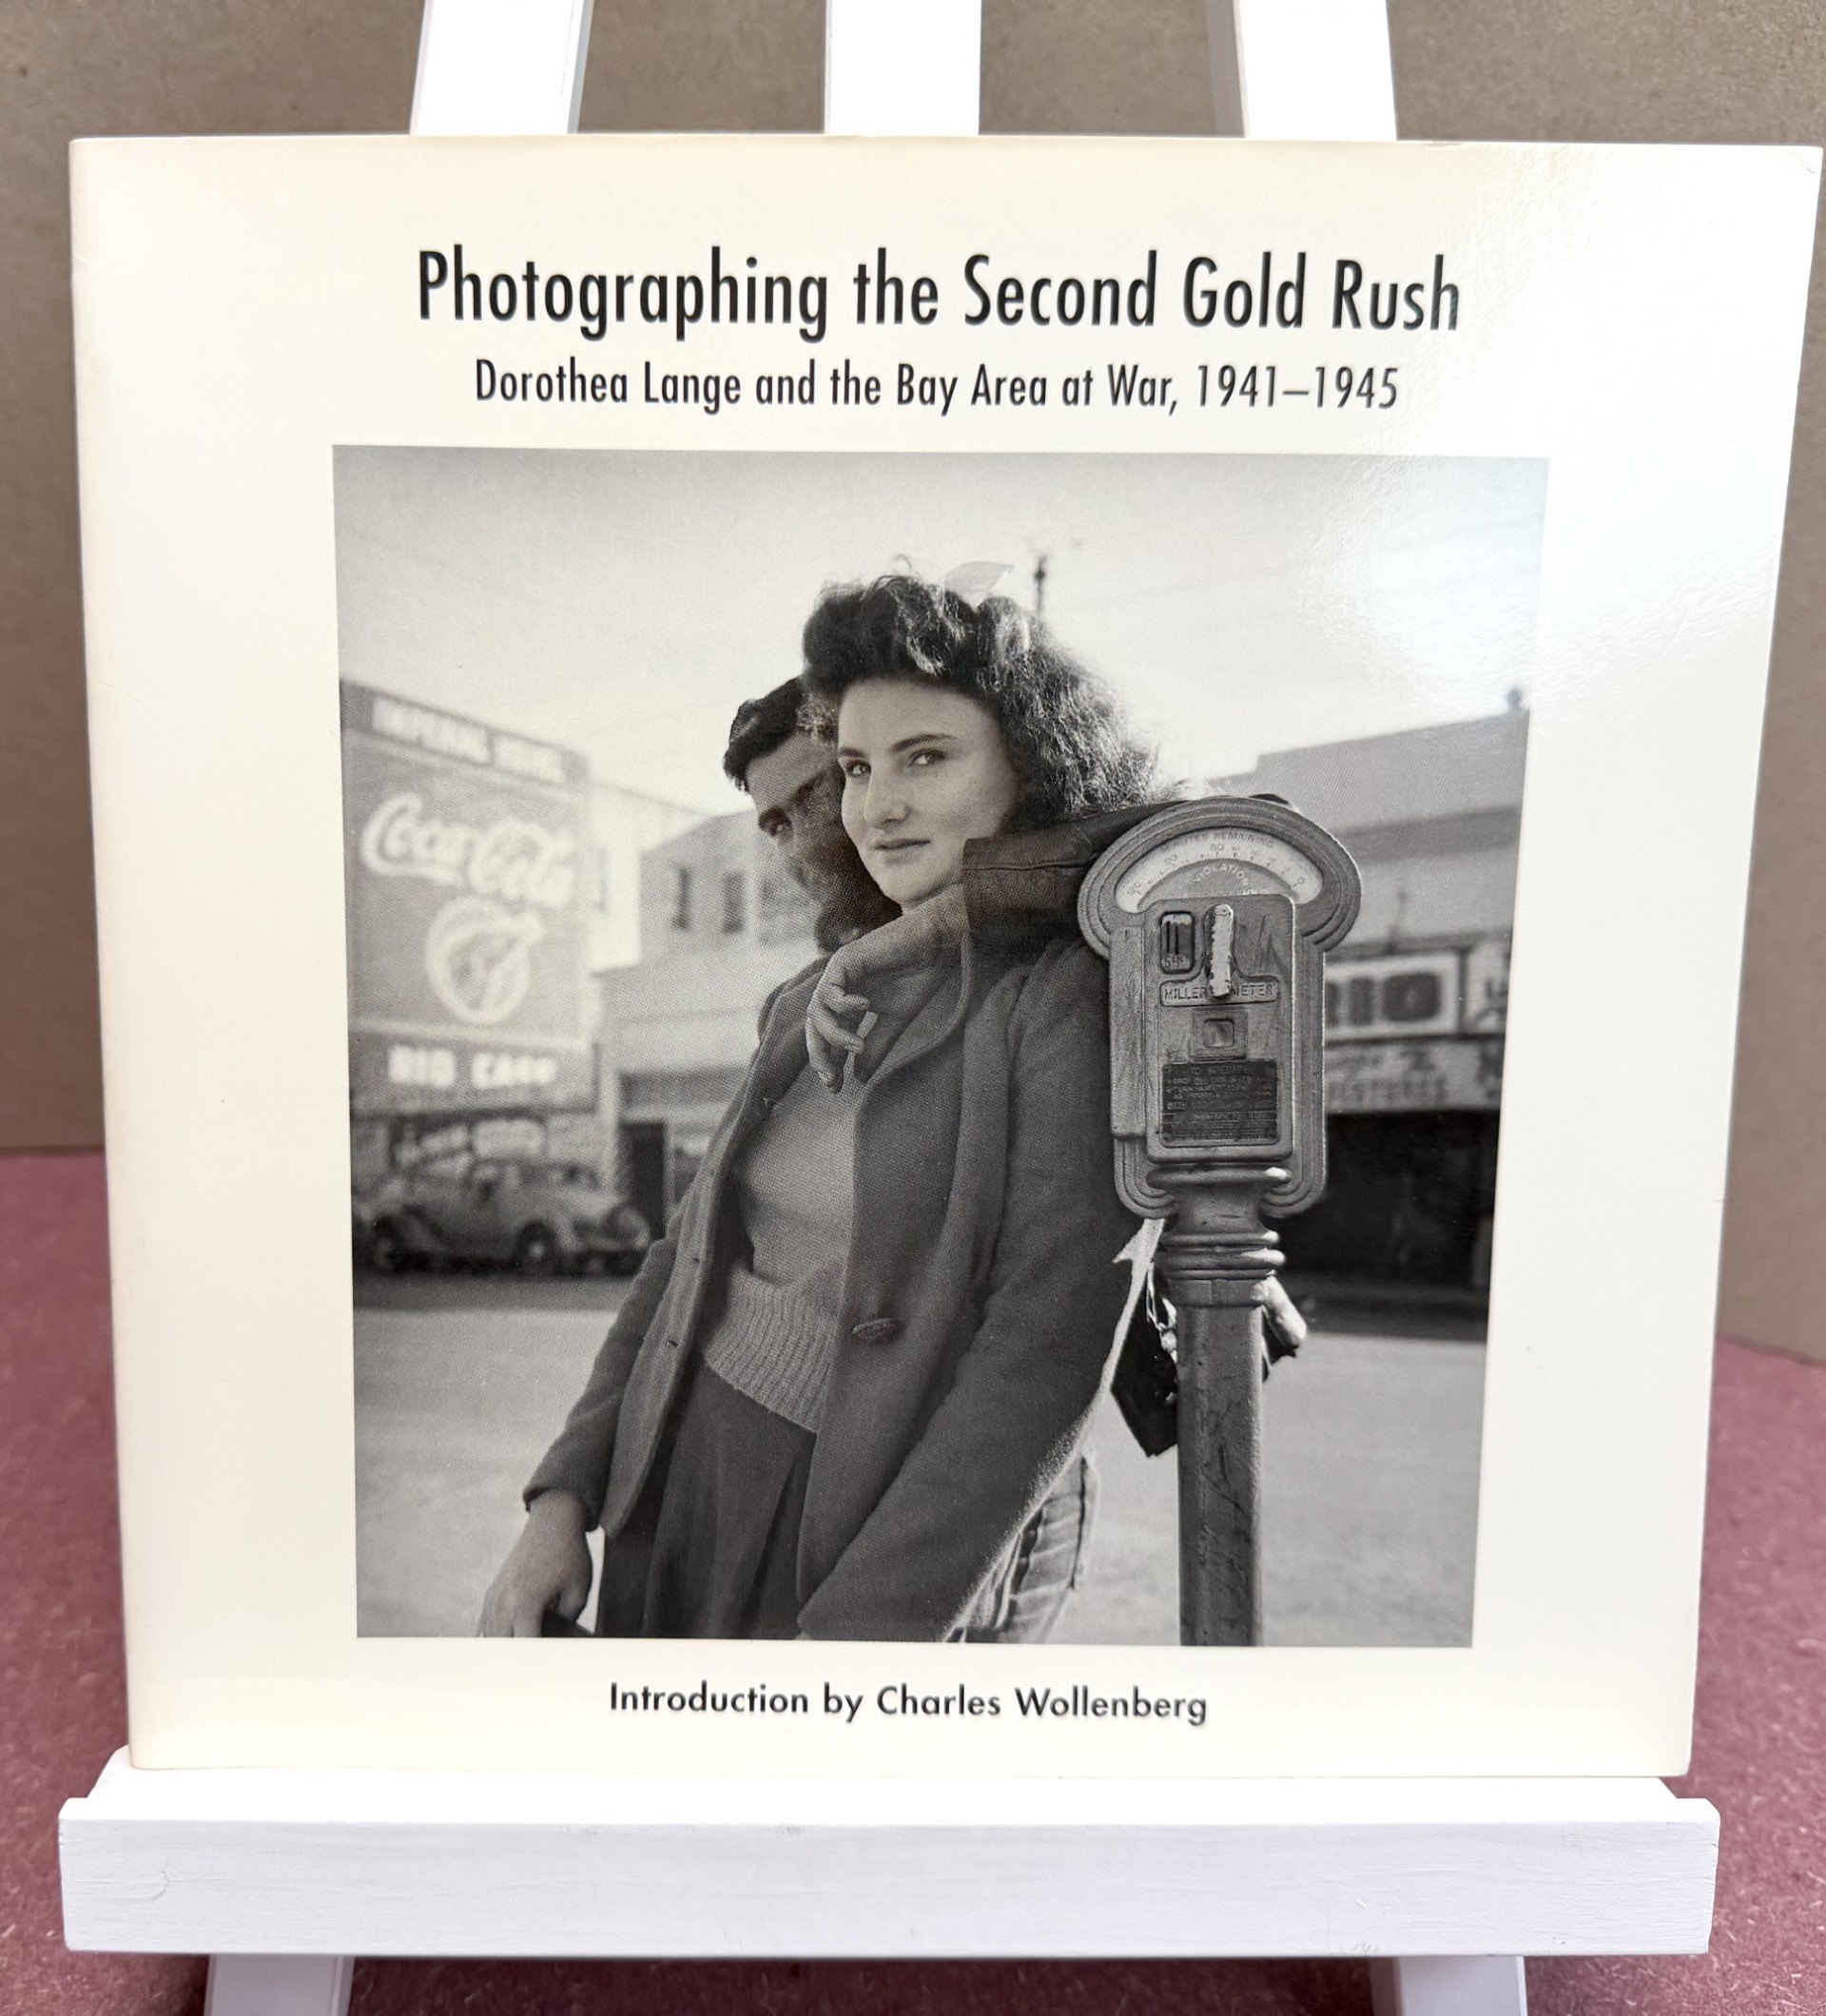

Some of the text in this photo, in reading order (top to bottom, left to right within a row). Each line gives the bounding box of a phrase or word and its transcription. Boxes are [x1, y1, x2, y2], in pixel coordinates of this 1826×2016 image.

[419, 243, 1460, 343] Photographing the Second Gold Rush
[476, 356, 628, 403] Dorothea
[644, 360, 741, 416] Lange
[755, 359, 815, 405] and
[829, 359, 882, 405] the
[897, 363, 959, 417] Bay
[970, 363, 1047, 406] Area
[1062, 370, 1094, 406] at
[1107, 364, 1177, 416] War,
[611, 1680, 1206, 1726] Introduction by Charles Wollenberg
